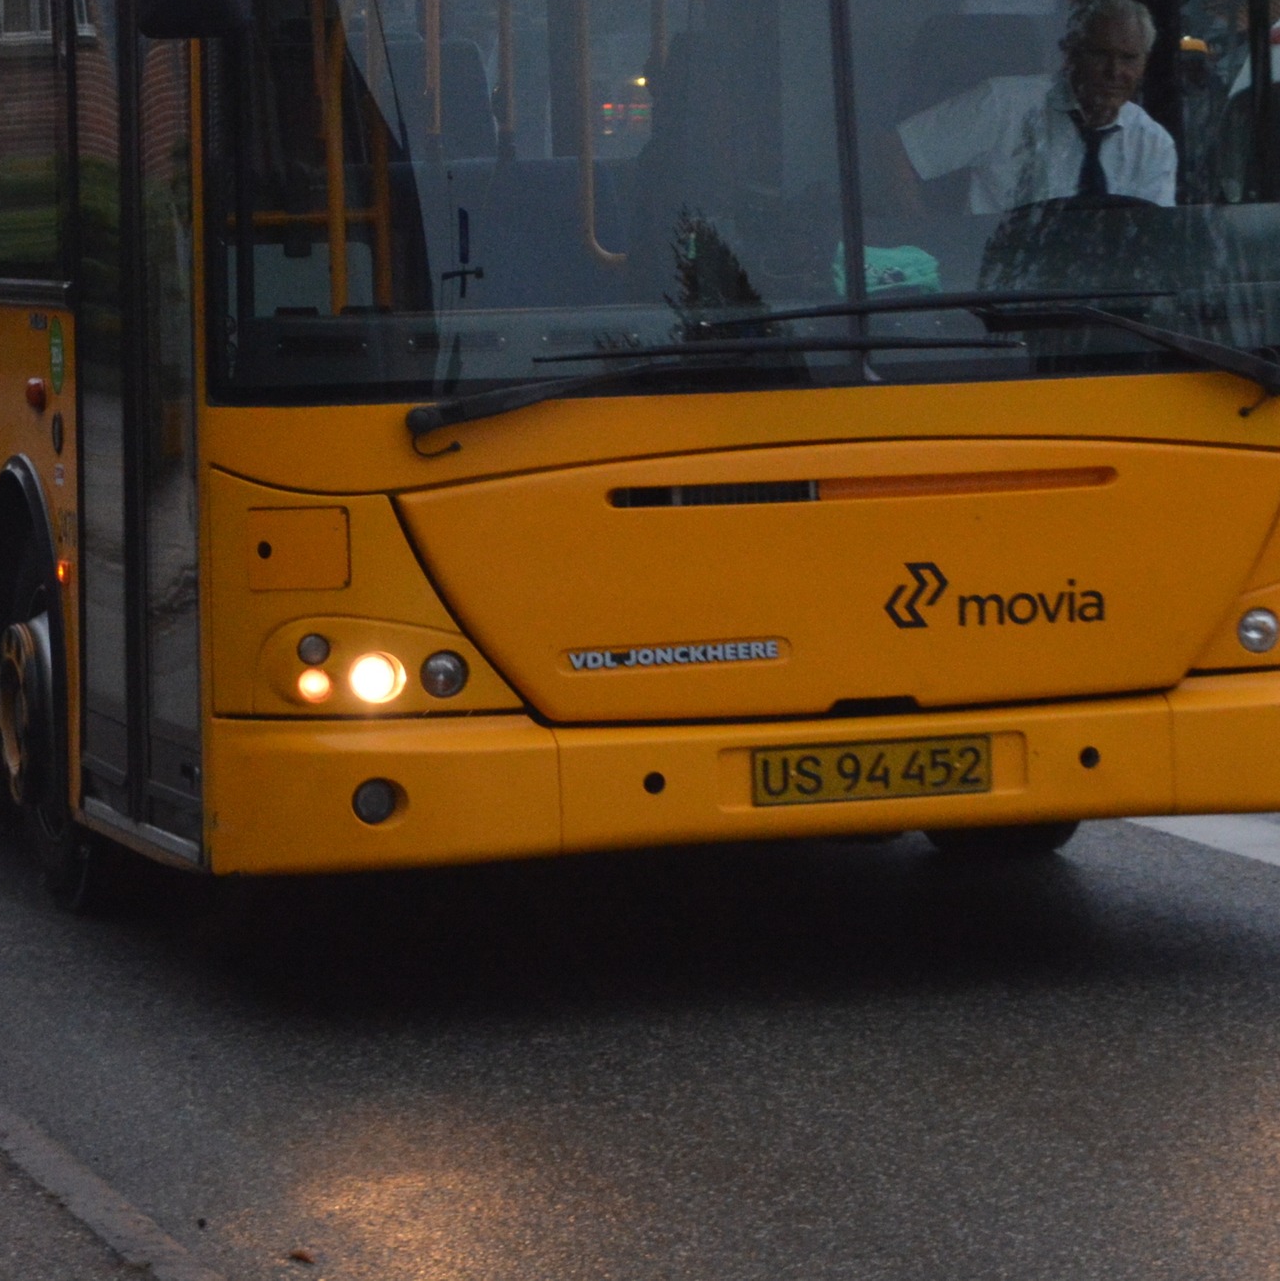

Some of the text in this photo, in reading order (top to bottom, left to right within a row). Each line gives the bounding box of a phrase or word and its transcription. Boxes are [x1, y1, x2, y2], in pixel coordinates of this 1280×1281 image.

[958, 578, 1106, 626] movia
[569, 640, 778, 669] VDL JONCKHEERE
[762, 746, 982, 796] US 94 452
